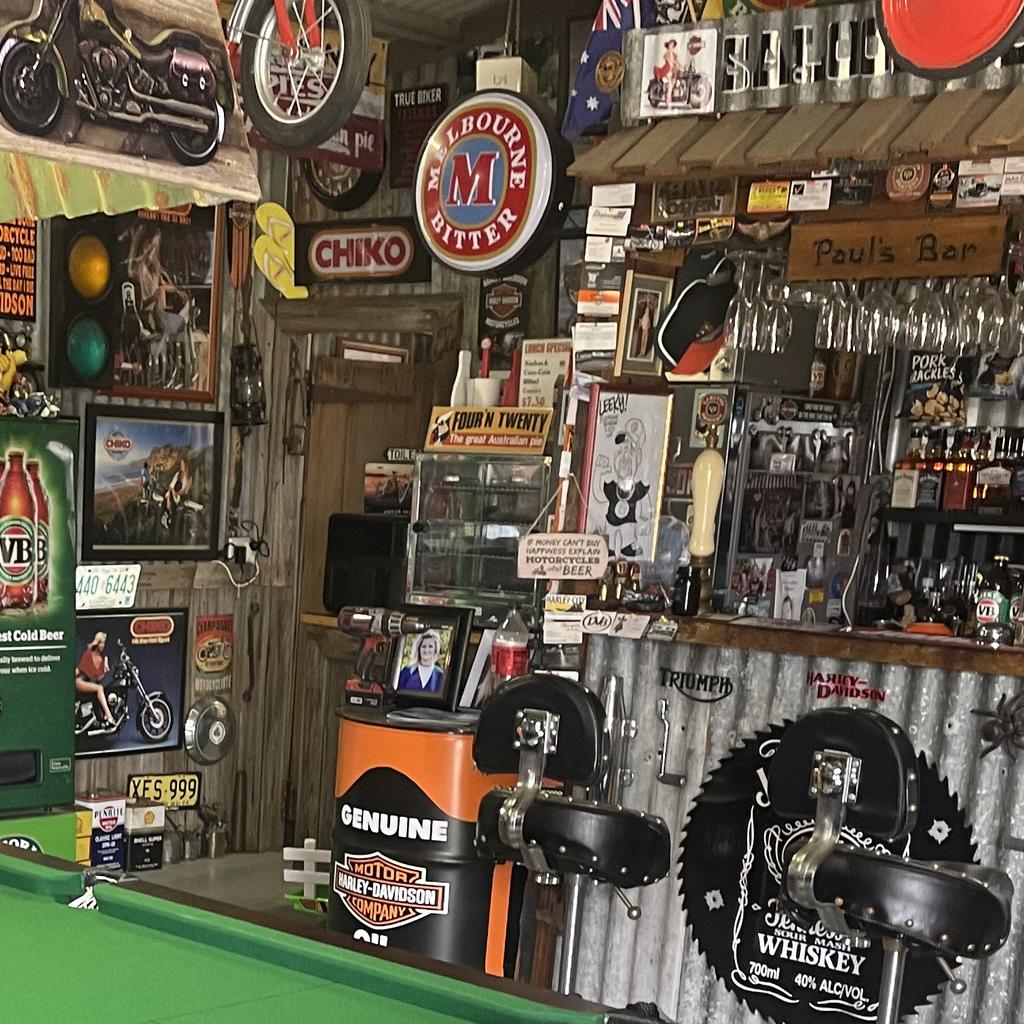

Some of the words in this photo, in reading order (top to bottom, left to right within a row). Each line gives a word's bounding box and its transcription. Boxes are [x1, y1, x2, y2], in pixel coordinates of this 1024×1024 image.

[394, 91, 415, 107] TRUE
[417, 87, 442, 104] BIKER
[354, 131, 375, 158] pie
[427, 112, 527, 192] MELBOURNE
[446, 152, 499, 207] M
[431, 208, 518, 250] BITTER
[315, 236, 406, 268] CHIKO
[813, 235, 895, 267] Paul's
[915, 233, 977, 266] Bar
[912, 354, 946, 370] PORK
[451, 409, 494, 431] FOUR'N
[498, 412, 549, 433] TWENTY
[449, 434, 464, 444] The
[465, 434, 487, 446] great
[488, 433, 527, 446] Australian
[529, 437, 543, 448] pie
[390, 449, 416, 460] TOILE
[526, 547, 567, 555] HAPPINESS
[568, 547, 601, 555] EXPLAIN
[535, 539, 561, 547] MONEY
[563, 538, 584, 547] CAN'T
[586, 539, 601, 547] BUY
[526, 556, 600, 564] MOTORCYCLES
[562, 565, 593, 577] BEER
[105, 574, 136, 595] 6443
[13, 629, 38, 642] Cold
[39, 629, 65, 642] Beer
[659, 667, 733, 702] TRIUMPH
[341, 804, 448, 841] GENUINE
[354, 861, 408, 882] MOTOR
[338, 871, 436, 905] HARLEY-DAVIDSON
[352, 896, 407, 921] COMPANY
[774, 928, 807, 942] SOUR
[814, 937, 851, 952] MASH
[758, 932, 866, 976] WHISKEY
[749, 961, 781, 980] 700ml
[794, 973, 817, 990] 40%
[819, 978, 870, 1003] ALC/VOL.
